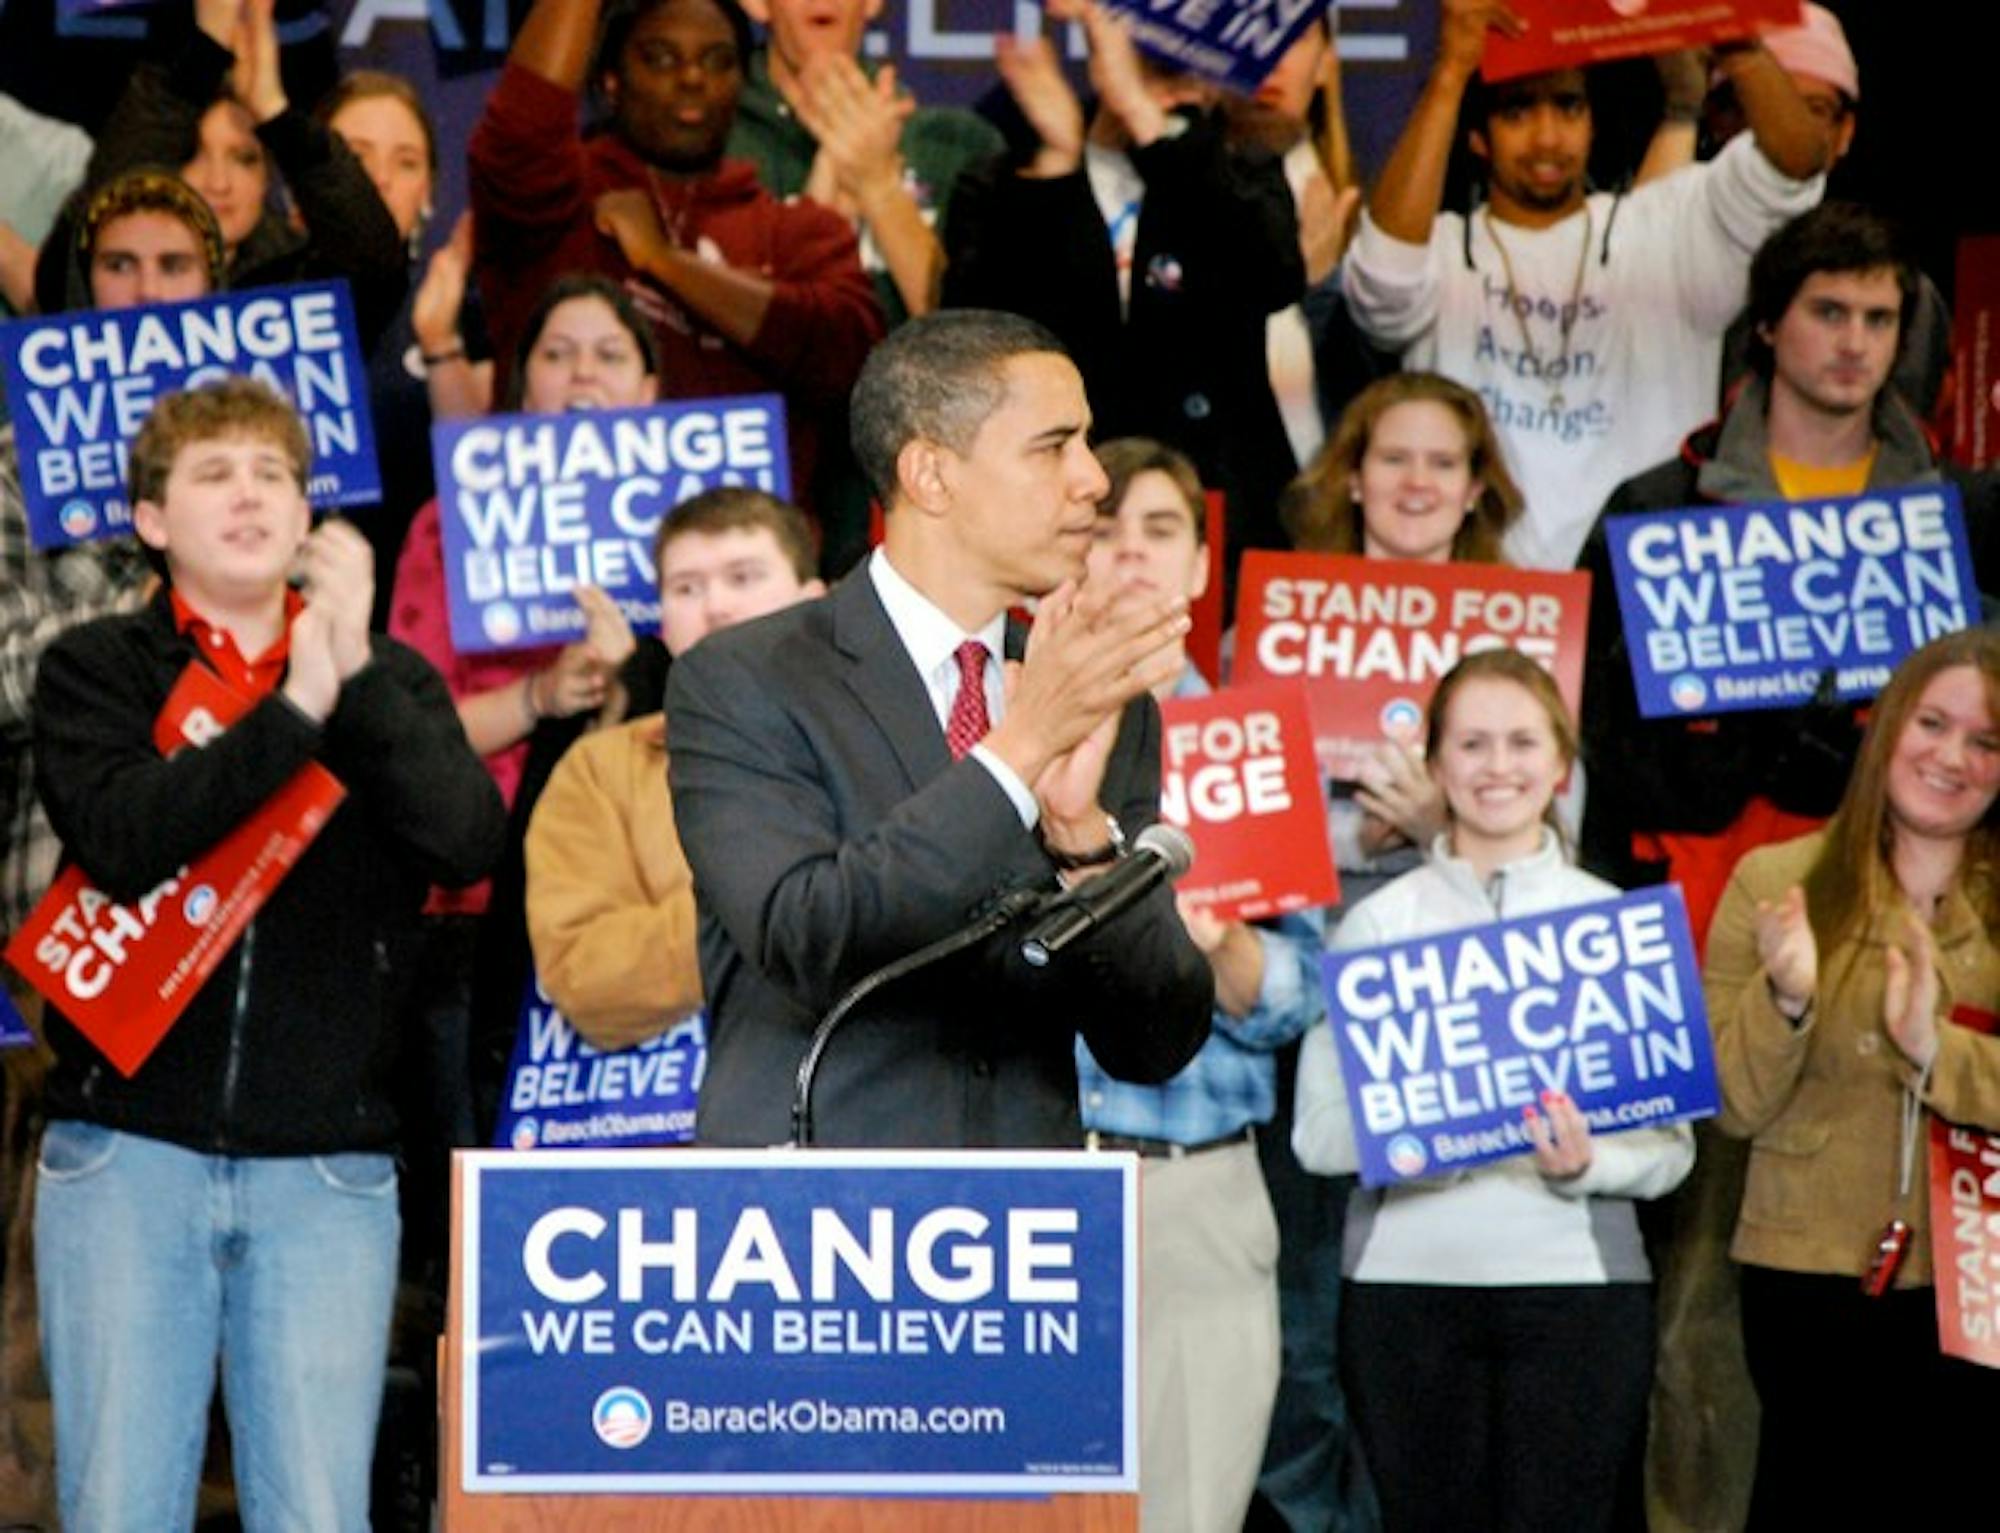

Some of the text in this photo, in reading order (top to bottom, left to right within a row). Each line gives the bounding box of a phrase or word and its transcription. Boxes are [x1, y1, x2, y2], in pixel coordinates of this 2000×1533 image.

[19, 292, 341, 388] CHANGE
[26, 376, 155, 447] WE
[452, 408, 772, 493] CHANGE
[458, 482, 591, 548] WE
[1627, 494, 1952, 578] CHANGE
[464, 539, 659, 602] BELIEV
[1263, 577, 1563, 636] STAND FOR
[1635, 550, 1967, 630] WE CAN
[1256, 620, 1559, 684] CHAN
[1646, 602, 1968, 674] BELIEVE IN
[1165, 710, 1283, 768] FOR
[1336, 902, 1674, 1020] CHANGE
[1345, 963, 1685, 1082] WE CAN
[510, 1049, 686, 1112] BELIEVE
[1360, 1026, 1695, 1135] BELIEVE IN
[522, 1206, 1080, 1302] CHANGE
[1952, 1166, 1992, 1345] STAND
[522, 1311, 1079, 1354] WE CAN BELIEVE IN
[665, 1401, 1006, 1434] BarackObama.com
